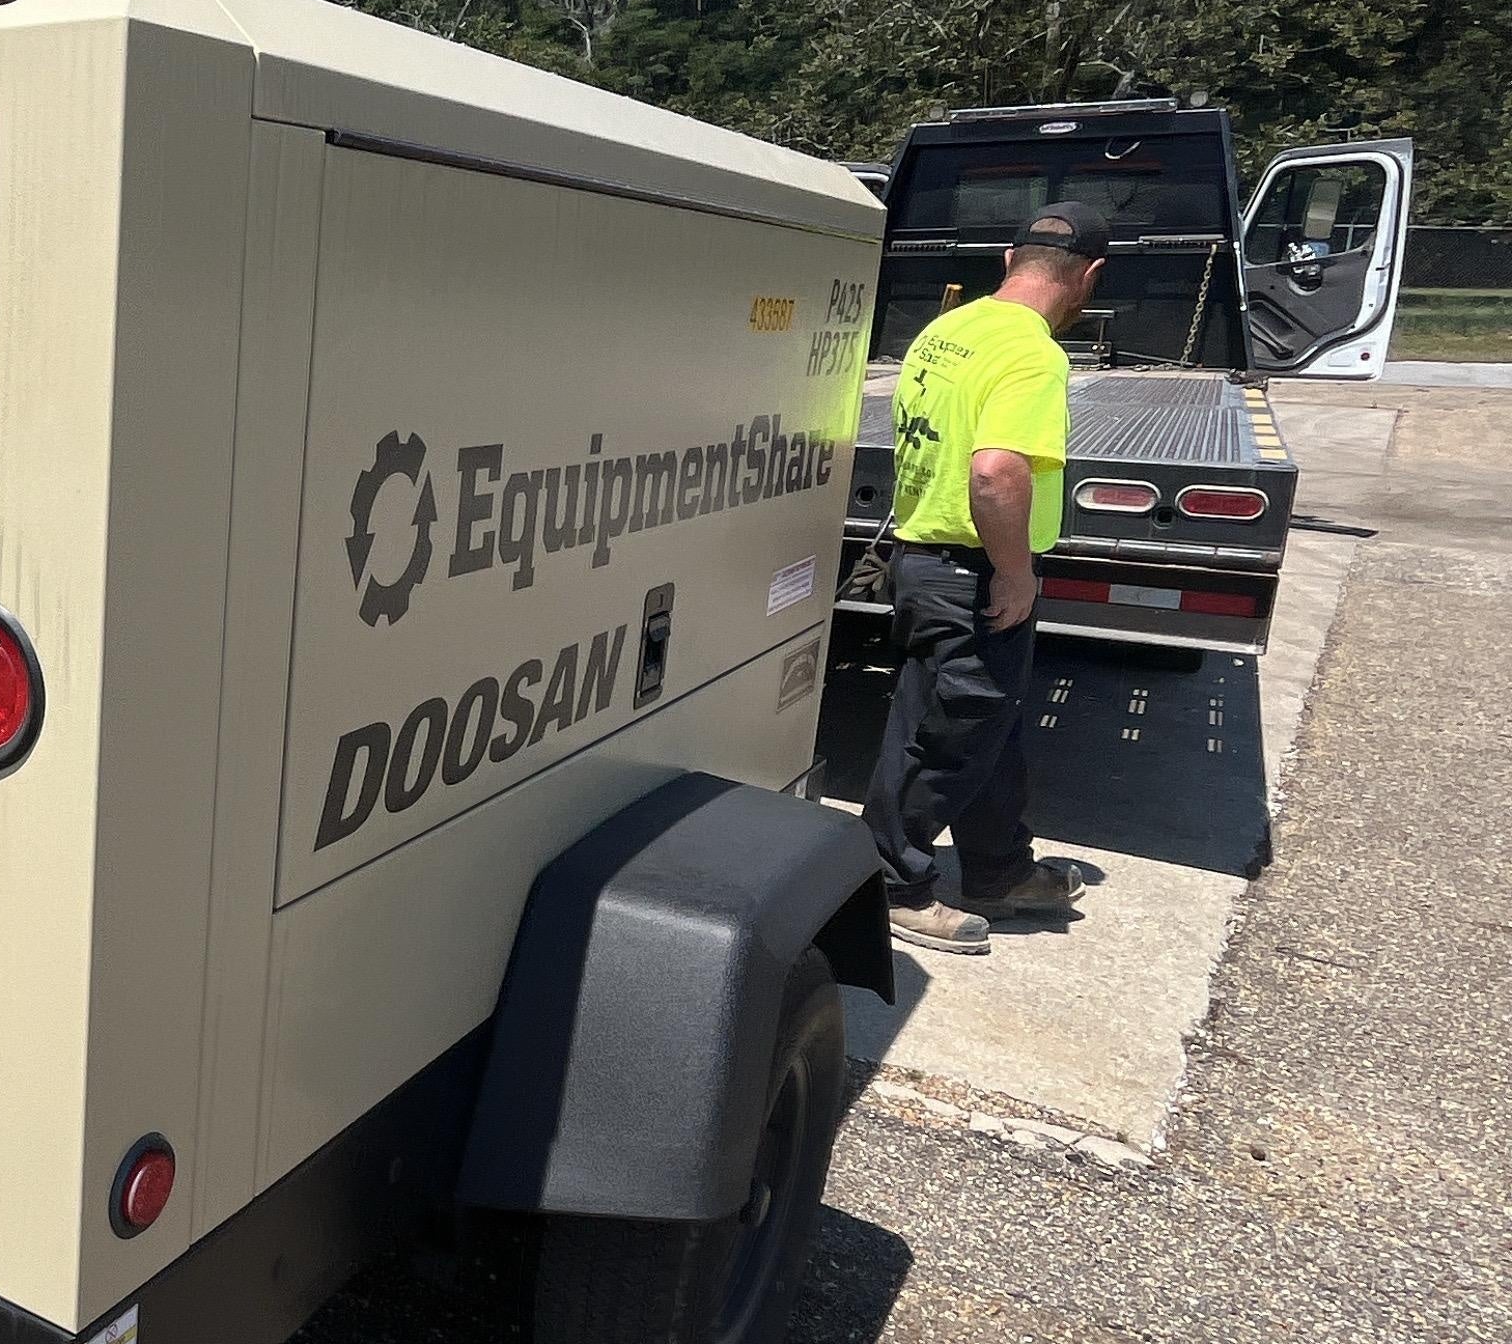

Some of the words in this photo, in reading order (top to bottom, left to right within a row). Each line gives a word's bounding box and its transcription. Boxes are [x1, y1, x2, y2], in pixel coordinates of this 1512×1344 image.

[807, 331, 859, 376] HP375
[826, 278, 865, 324] P425
[448, 413, 835, 592] EquipmentShare
[313, 623, 627, 853] DOOSAN
